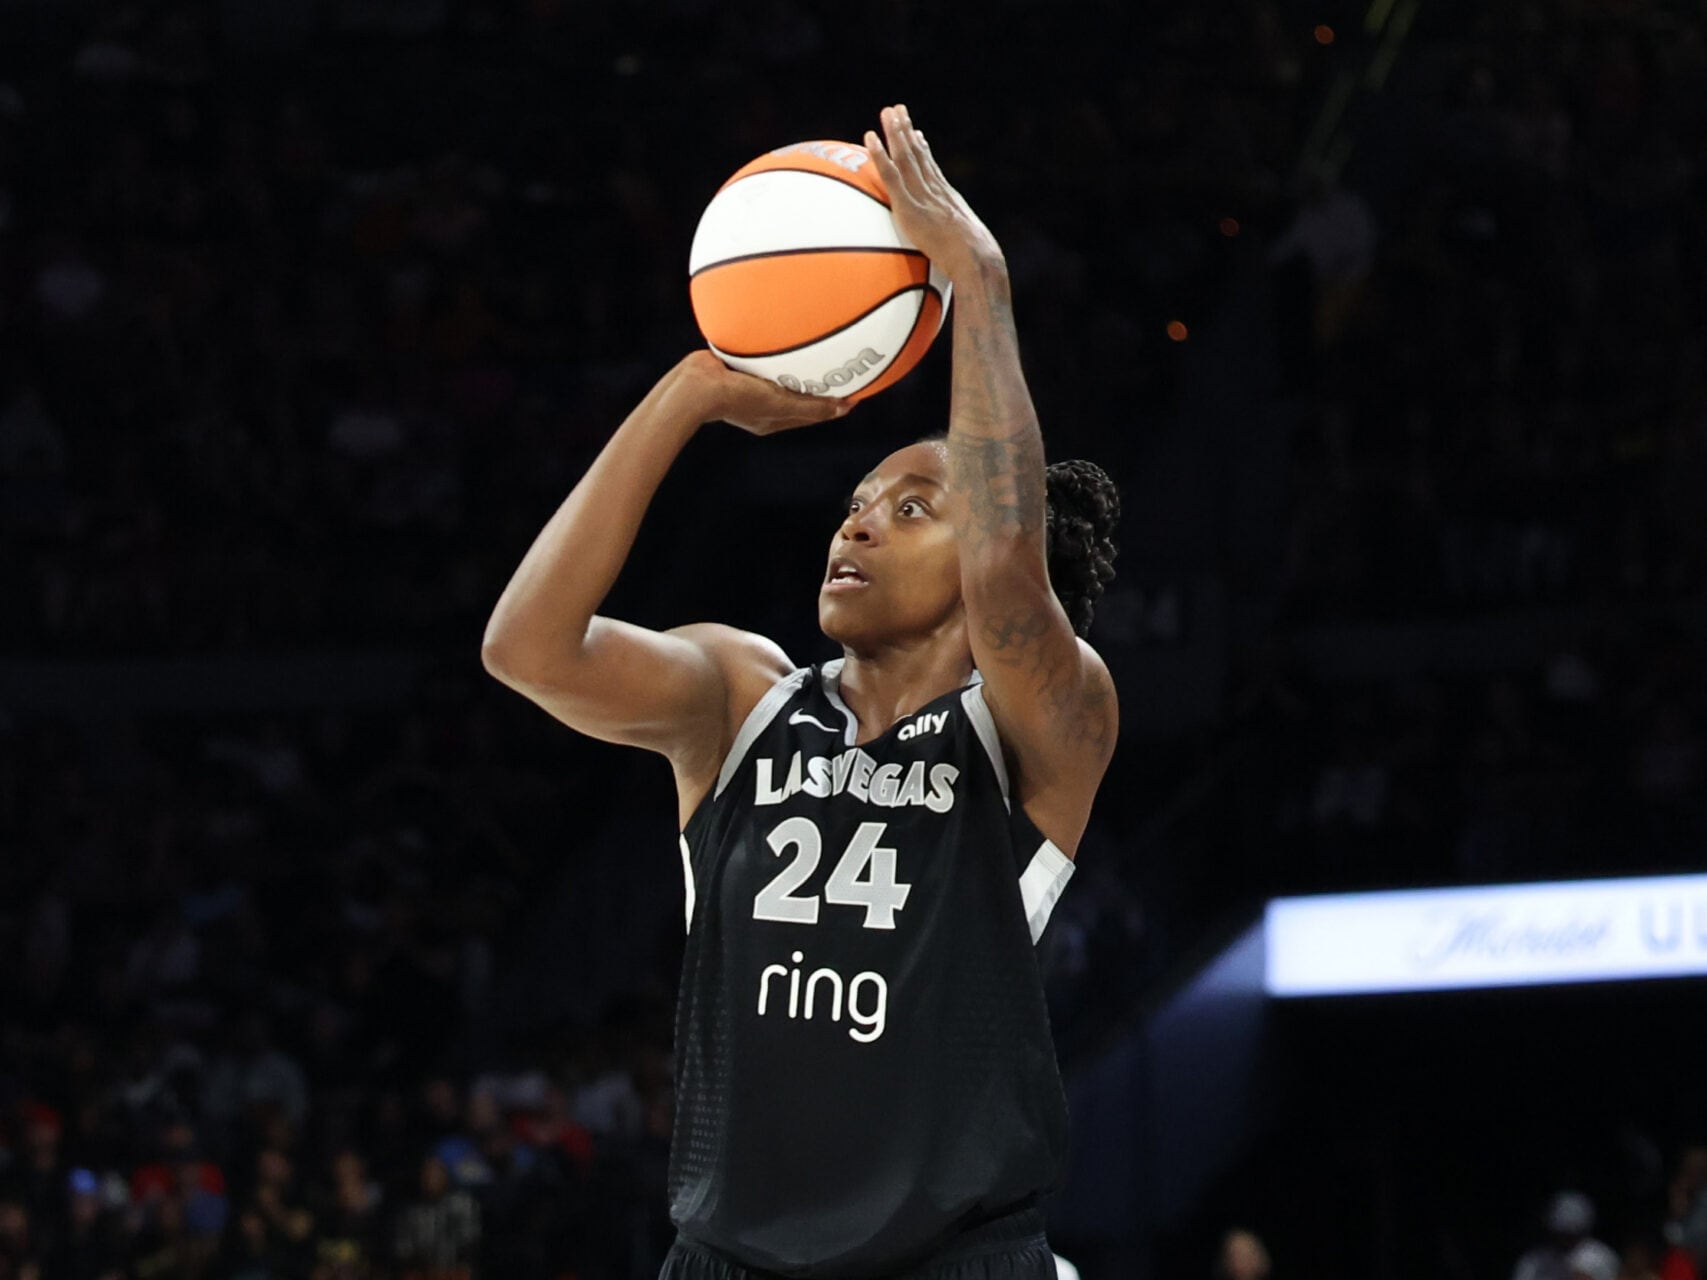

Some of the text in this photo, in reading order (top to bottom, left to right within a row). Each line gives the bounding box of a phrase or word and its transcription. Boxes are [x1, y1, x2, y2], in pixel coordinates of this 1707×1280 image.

[897, 709, 950, 741] ally
[753, 816, 912, 930] 24
[757, 950, 888, 1043] ring
